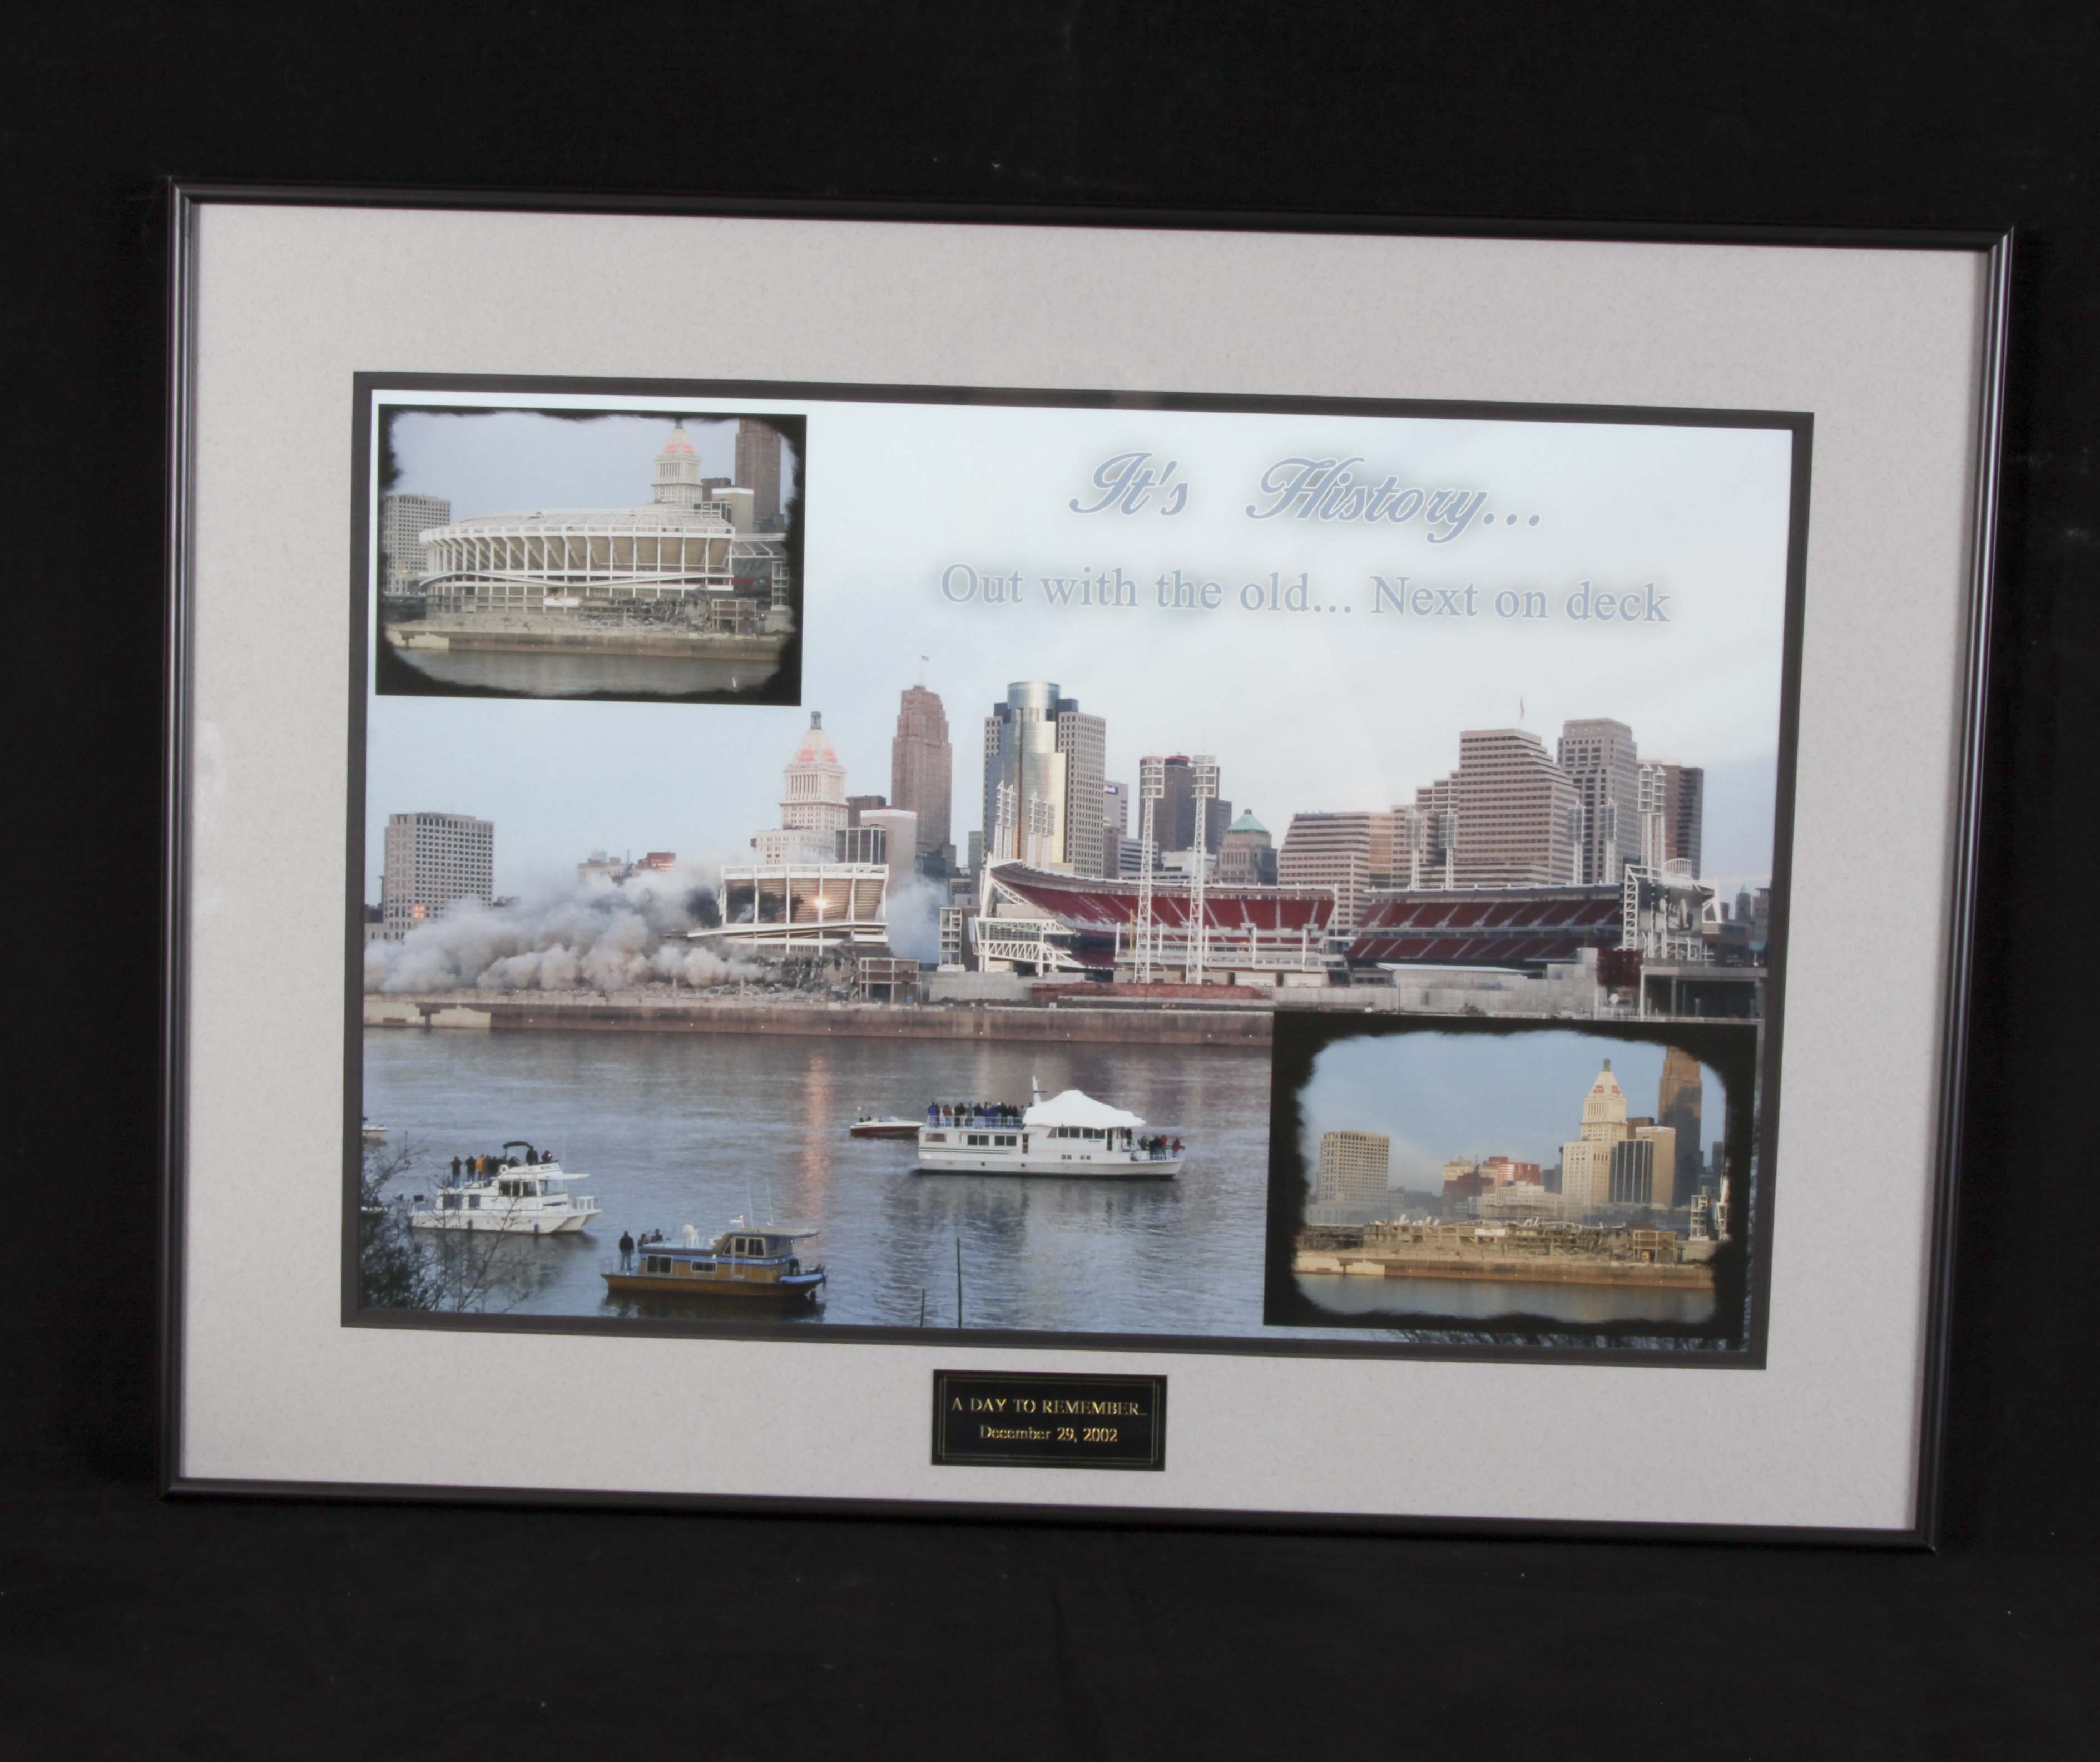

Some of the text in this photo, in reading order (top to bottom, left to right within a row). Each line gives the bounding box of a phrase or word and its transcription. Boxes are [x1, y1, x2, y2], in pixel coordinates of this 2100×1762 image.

[1070, 452, 1541, 543] It's History...
[941, 564, 1671, 622] Out with the old... Next on deck
[952, 1397, 963, 1412] A
[970, 1398, 1007, 1412] DAY
[1013, 1399, 1036, 1413] TO
[980, 1425, 1118, 1443] December 29, 2002
